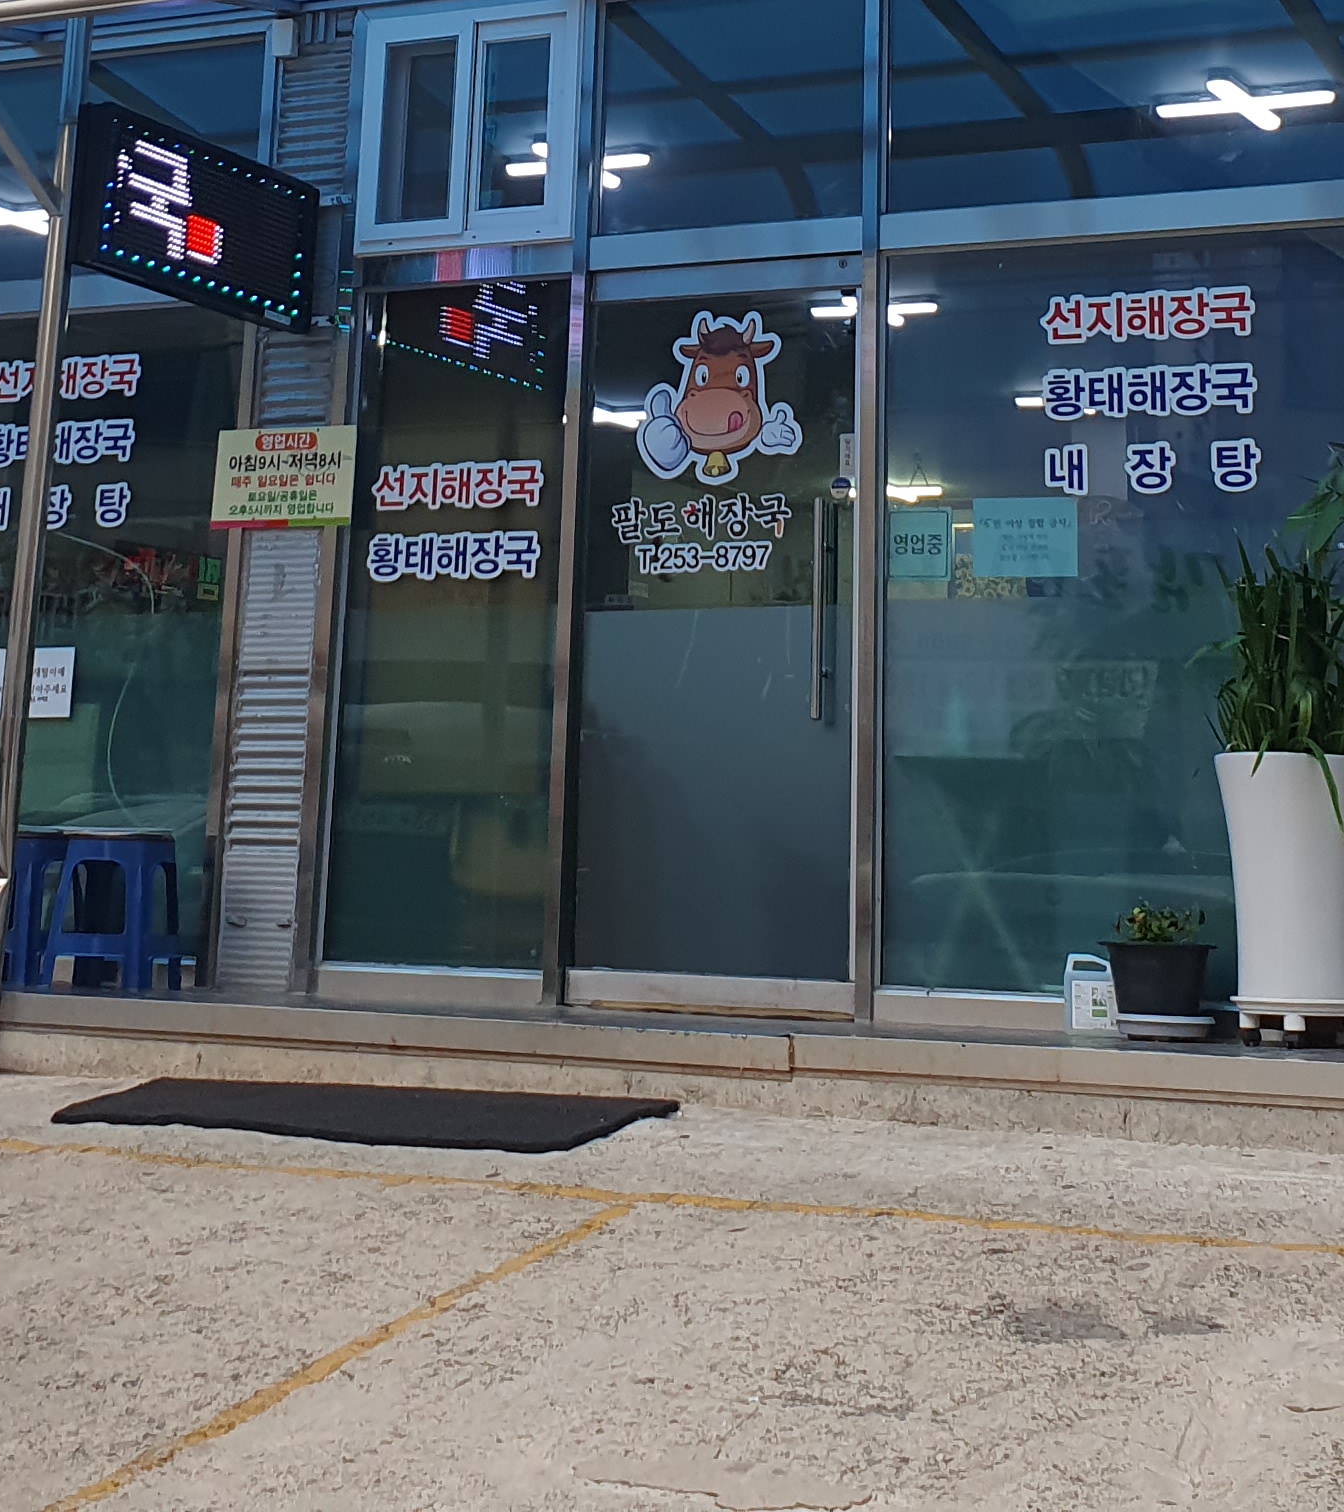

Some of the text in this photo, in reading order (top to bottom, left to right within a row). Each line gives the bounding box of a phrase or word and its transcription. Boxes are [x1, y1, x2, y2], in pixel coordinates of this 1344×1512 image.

[1044, 288, 1253, 342] 선지해장국
[1044, 365, 1256, 419] 황태해장국
[262, 434, 310, 450] 영업시간
[231, 476, 251, 488] 매주
[258, 475, 298, 487] 일요일은
[374, 460, 543, 511] 선지해장국
[287, 502, 334, 515] 영업합니다
[368, 531, 539, 582] 황태해장국
[893, 533, 942, 555] 영업중
